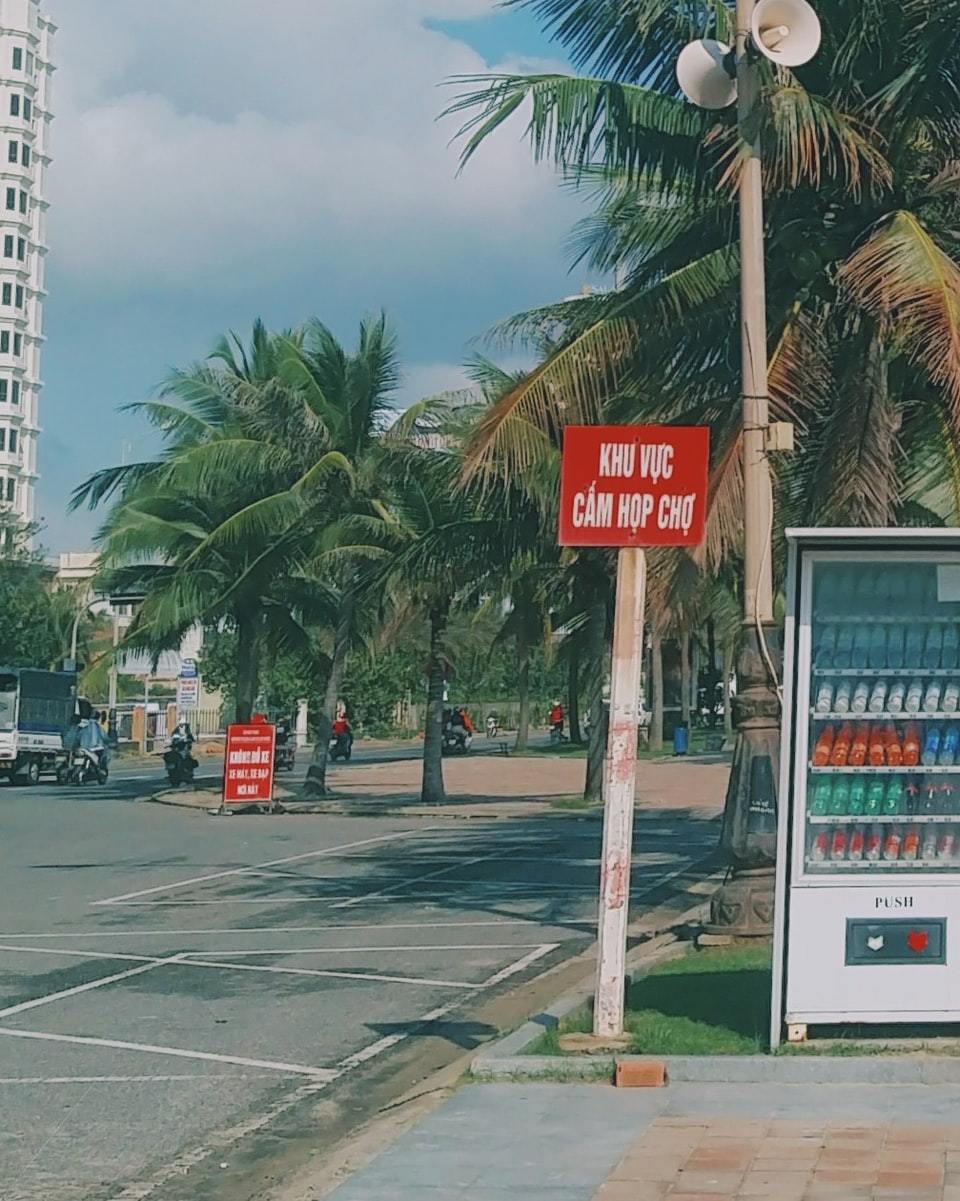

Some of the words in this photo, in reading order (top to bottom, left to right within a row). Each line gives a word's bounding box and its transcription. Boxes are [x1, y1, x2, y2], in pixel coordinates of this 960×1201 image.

[599, 443, 635, 478] KHU
[640, 443, 674, 485] VỰC
[572, 480, 613, 528] CẤM
[617, 493, 653, 534] HỌP
[657, 493, 696, 536] CHỢ
[875, 896, 913, 908] PUSH
